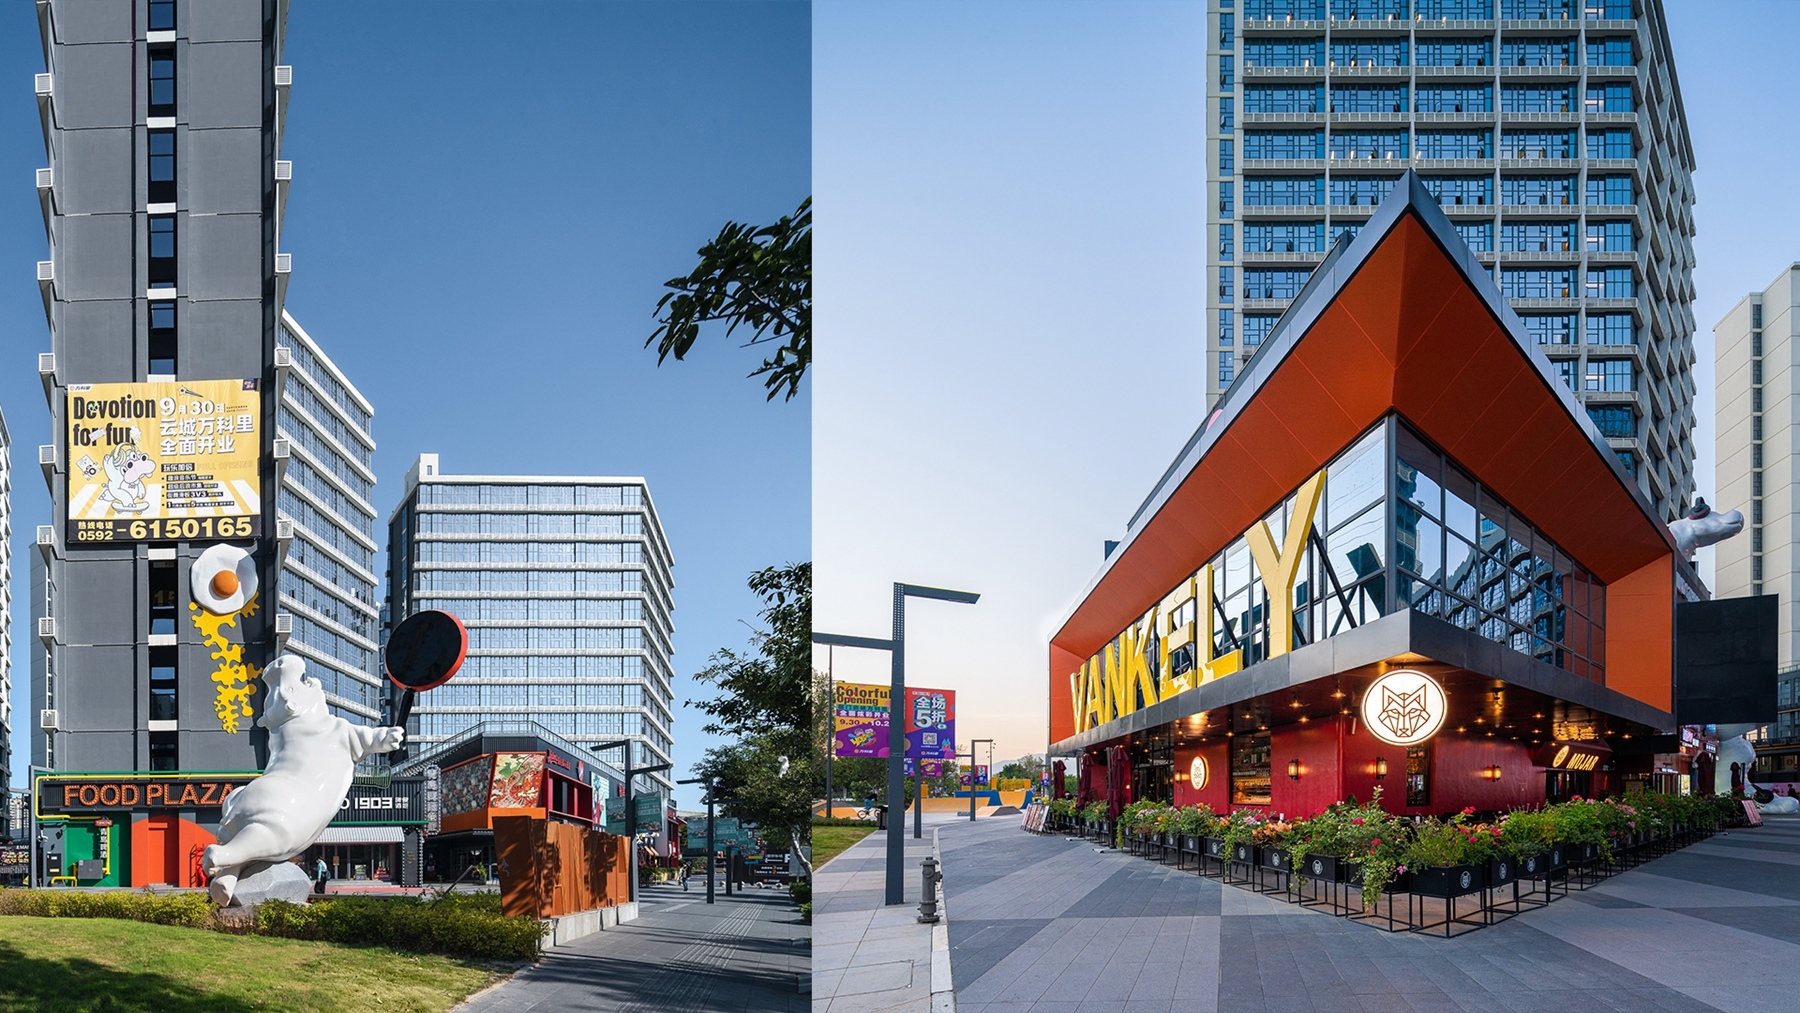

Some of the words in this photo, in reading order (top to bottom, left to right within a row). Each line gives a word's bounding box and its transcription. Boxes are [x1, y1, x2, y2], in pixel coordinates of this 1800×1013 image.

[73, 394, 156, 419] Devotion
[159, 414, 254, 437] 云城万科里
[160, 435, 236, 456] 全面开业
[78, 531, 114, 541] 0592
[1070, 470, 1327, 735] VANKELY
[837, 695, 879, 706] Opening
[915, 696, 946, 710] 全场
[64, 784, 141, 806] FOOD
[354, 797, 393, 810] 1903
